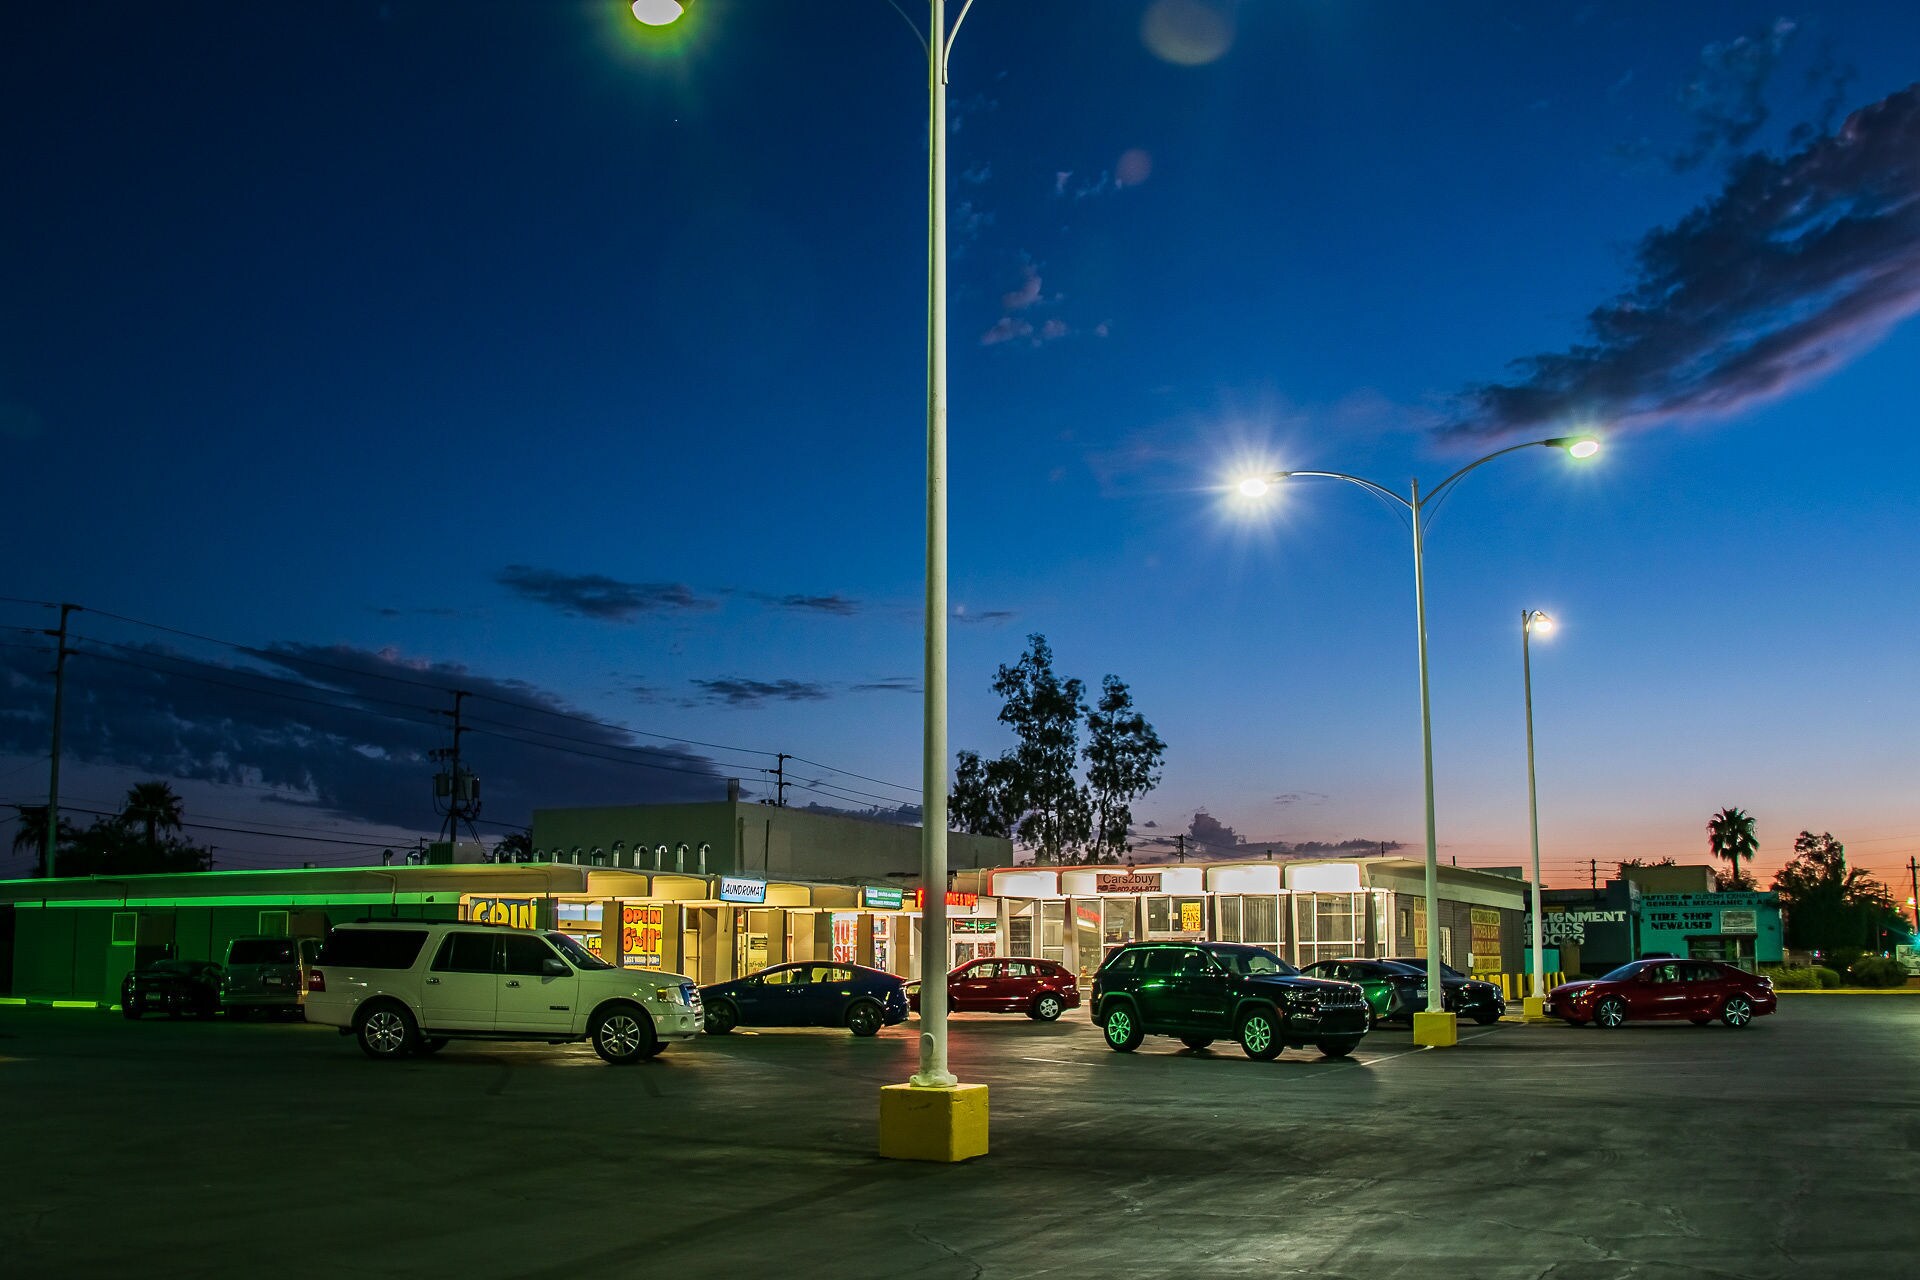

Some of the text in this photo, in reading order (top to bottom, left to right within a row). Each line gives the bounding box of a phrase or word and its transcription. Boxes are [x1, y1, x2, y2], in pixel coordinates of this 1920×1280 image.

[1103, 874, 1154, 885] Cars2buy
[722, 883, 764, 897] LAUNDROMAT
[473, 901, 537, 930] COIN
[624, 908, 662, 924] OPEN
[1183, 912, 1199, 922] FANS
[1649, 912, 1713, 921] TIRE SHOP
[1182, 922, 1200, 931] SALE
[1524, 922, 1584, 934] AKES
[1524, 933, 1585, 945] OCKS
